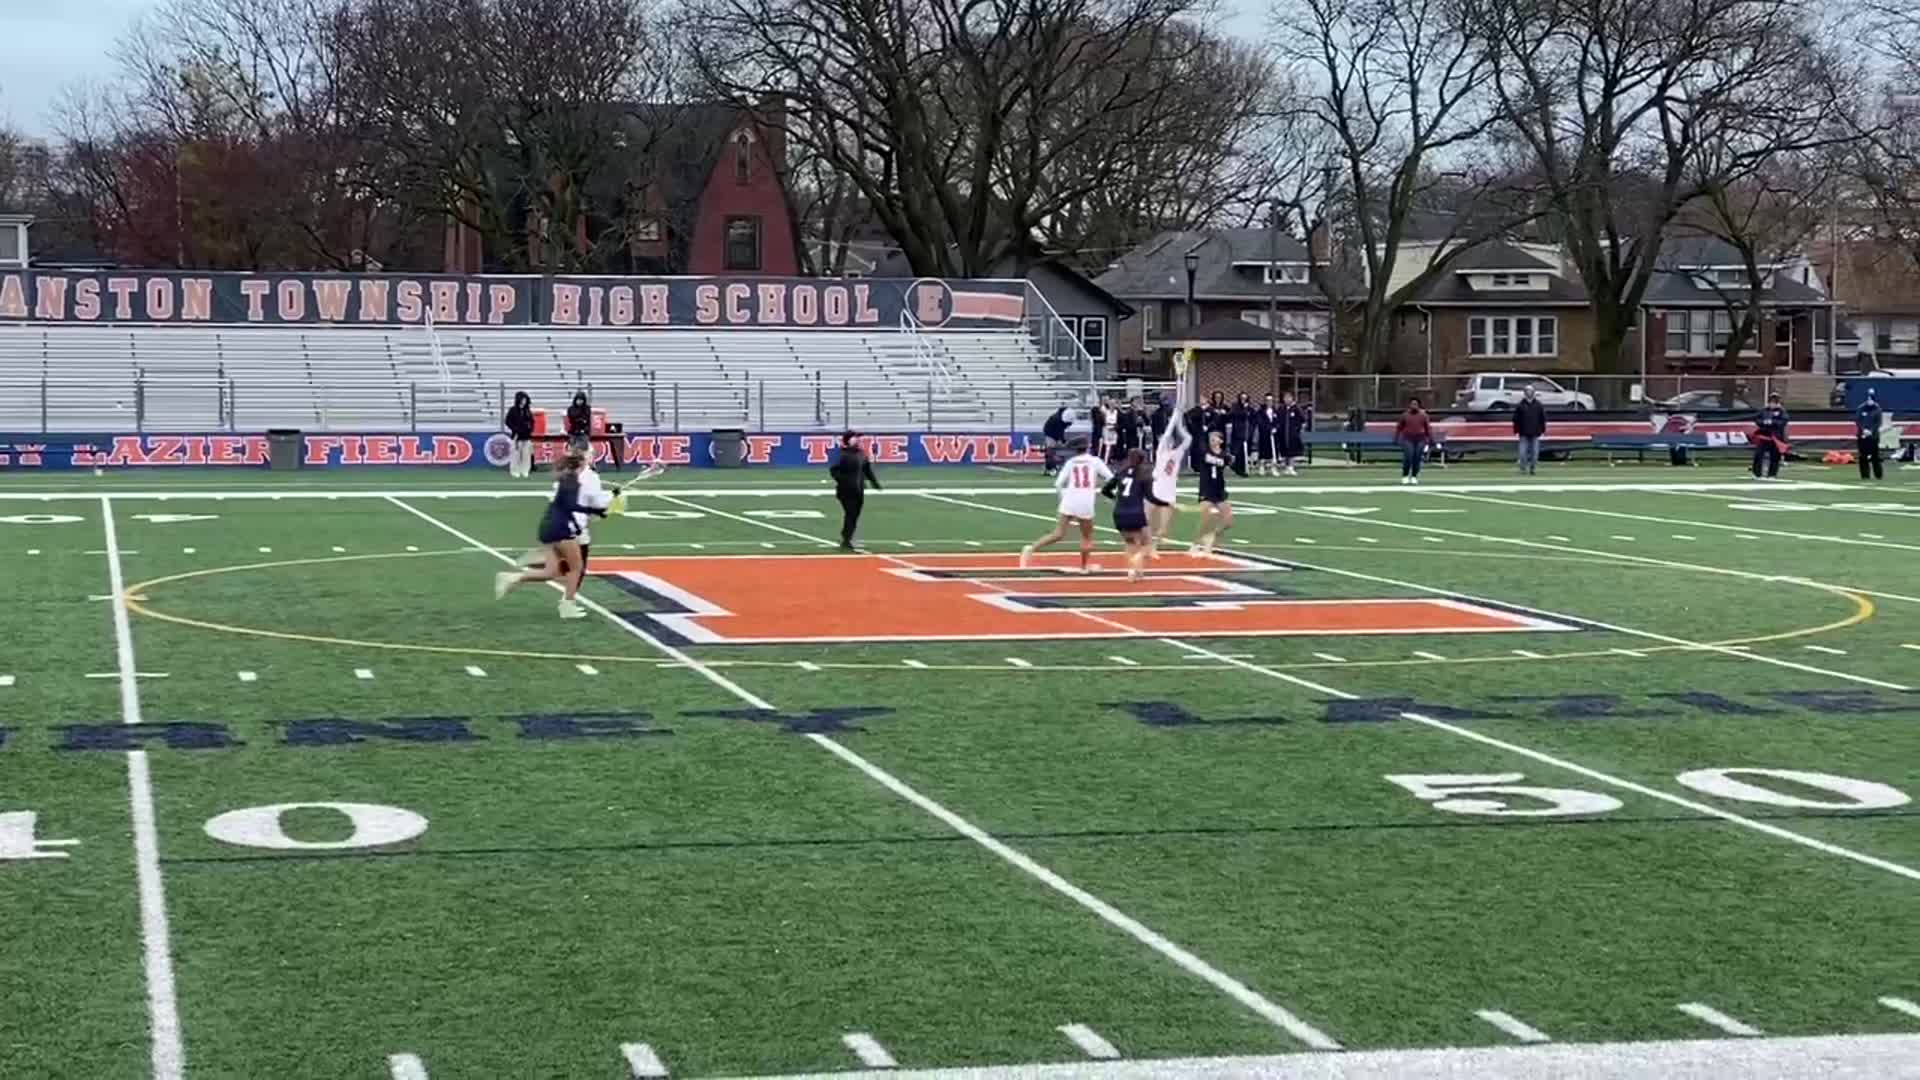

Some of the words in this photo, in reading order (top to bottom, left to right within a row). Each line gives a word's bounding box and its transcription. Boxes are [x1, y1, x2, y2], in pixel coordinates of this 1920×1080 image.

[241, 279, 517, 325] TOWNSHIP
[551, 283, 671, 326] HIGH
[695, 283, 880, 325] SCHOOL
[304, 436, 473, 465] FIELD
[1071, 464, 1091, 489] 11
[1121, 477, 1134, 497] 7
